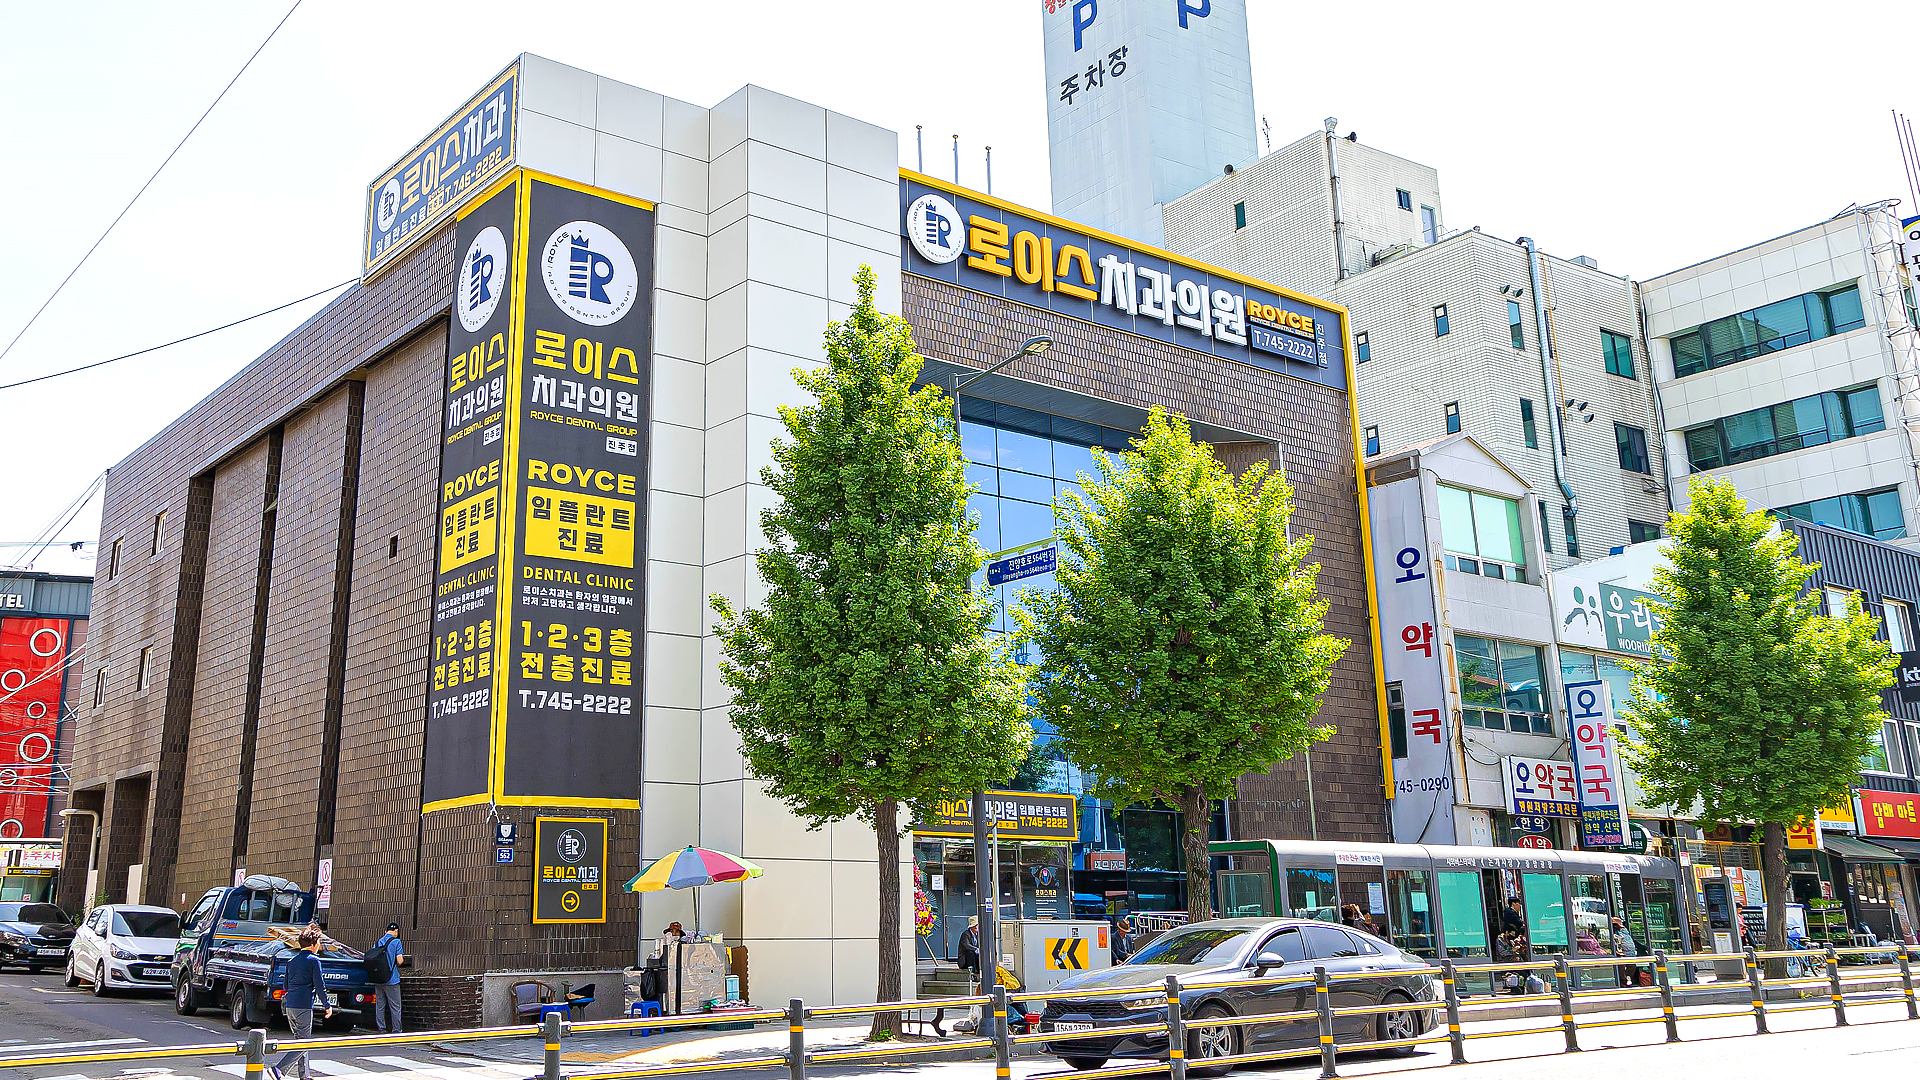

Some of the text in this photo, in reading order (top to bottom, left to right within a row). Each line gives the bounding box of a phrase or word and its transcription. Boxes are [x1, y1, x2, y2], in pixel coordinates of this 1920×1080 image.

[1072, 0, 1098, 52] P
[1059, 45, 1129, 106] 주차장
[401, 90, 507, 214] 로이스치과
[444, 146, 503, 202] T.745-2222
[967, 214, 1249, 347] 로이스치과의원
[1246, 299, 1314, 333] ROYCE
[532, 329, 639, 385] 로이스
[1253, 330, 1314, 359] T.745-2222
[1316, 323, 1327, 365] 진주점
[450, 332, 505, 394] 로이스
[448, 374, 505, 430] 치과의원
[531, 374, 639, 423] 치과의원
[530, 410, 638, 436] ROYCE DENTAL GROUP
[607, 440, 636, 455] 진주점
[444, 459, 500, 503] ROYCE
[527, 459, 636, 496] ROYCE
[444, 496, 496, 538] 임플란트
[531, 495, 631, 531] 임플란트
[455, 529, 480, 560] 진료
[557, 527, 604, 555] 진료
[1008, 549, 1055, 571] 진양호로564번길
[438, 565, 495, 597] DENTAL CLINIC
[523, 566, 634, 591] DENTAL CLINIC
[522, 585, 634, 607] 로이스치과는 환자의 입장에서
[522, 595, 540, 606] 먼저
[540, 597, 575, 610] 고민하고
[1395, 546, 1442, 745] 오약국
[433, 651, 491, 692] 전층진료
[520, 652, 633, 686] 전층진료
[432, 688, 490, 719] T.745-2222
[518, 689, 632, 715] T.745-2222
[1574, 689, 1612, 802] 오약국
[1516, 762, 1576, 801] 오약국
[1019, 816, 1068, 829] T.745-2222
[1518, 800, 1578, 816] 병원처방조제전문
[1520, 817, 1545, 831] 한약
[1872, 802, 1895, 829] 담배
[1896, 800, 1917, 823] 마트
[542, 865, 599, 879] 로이스치과
